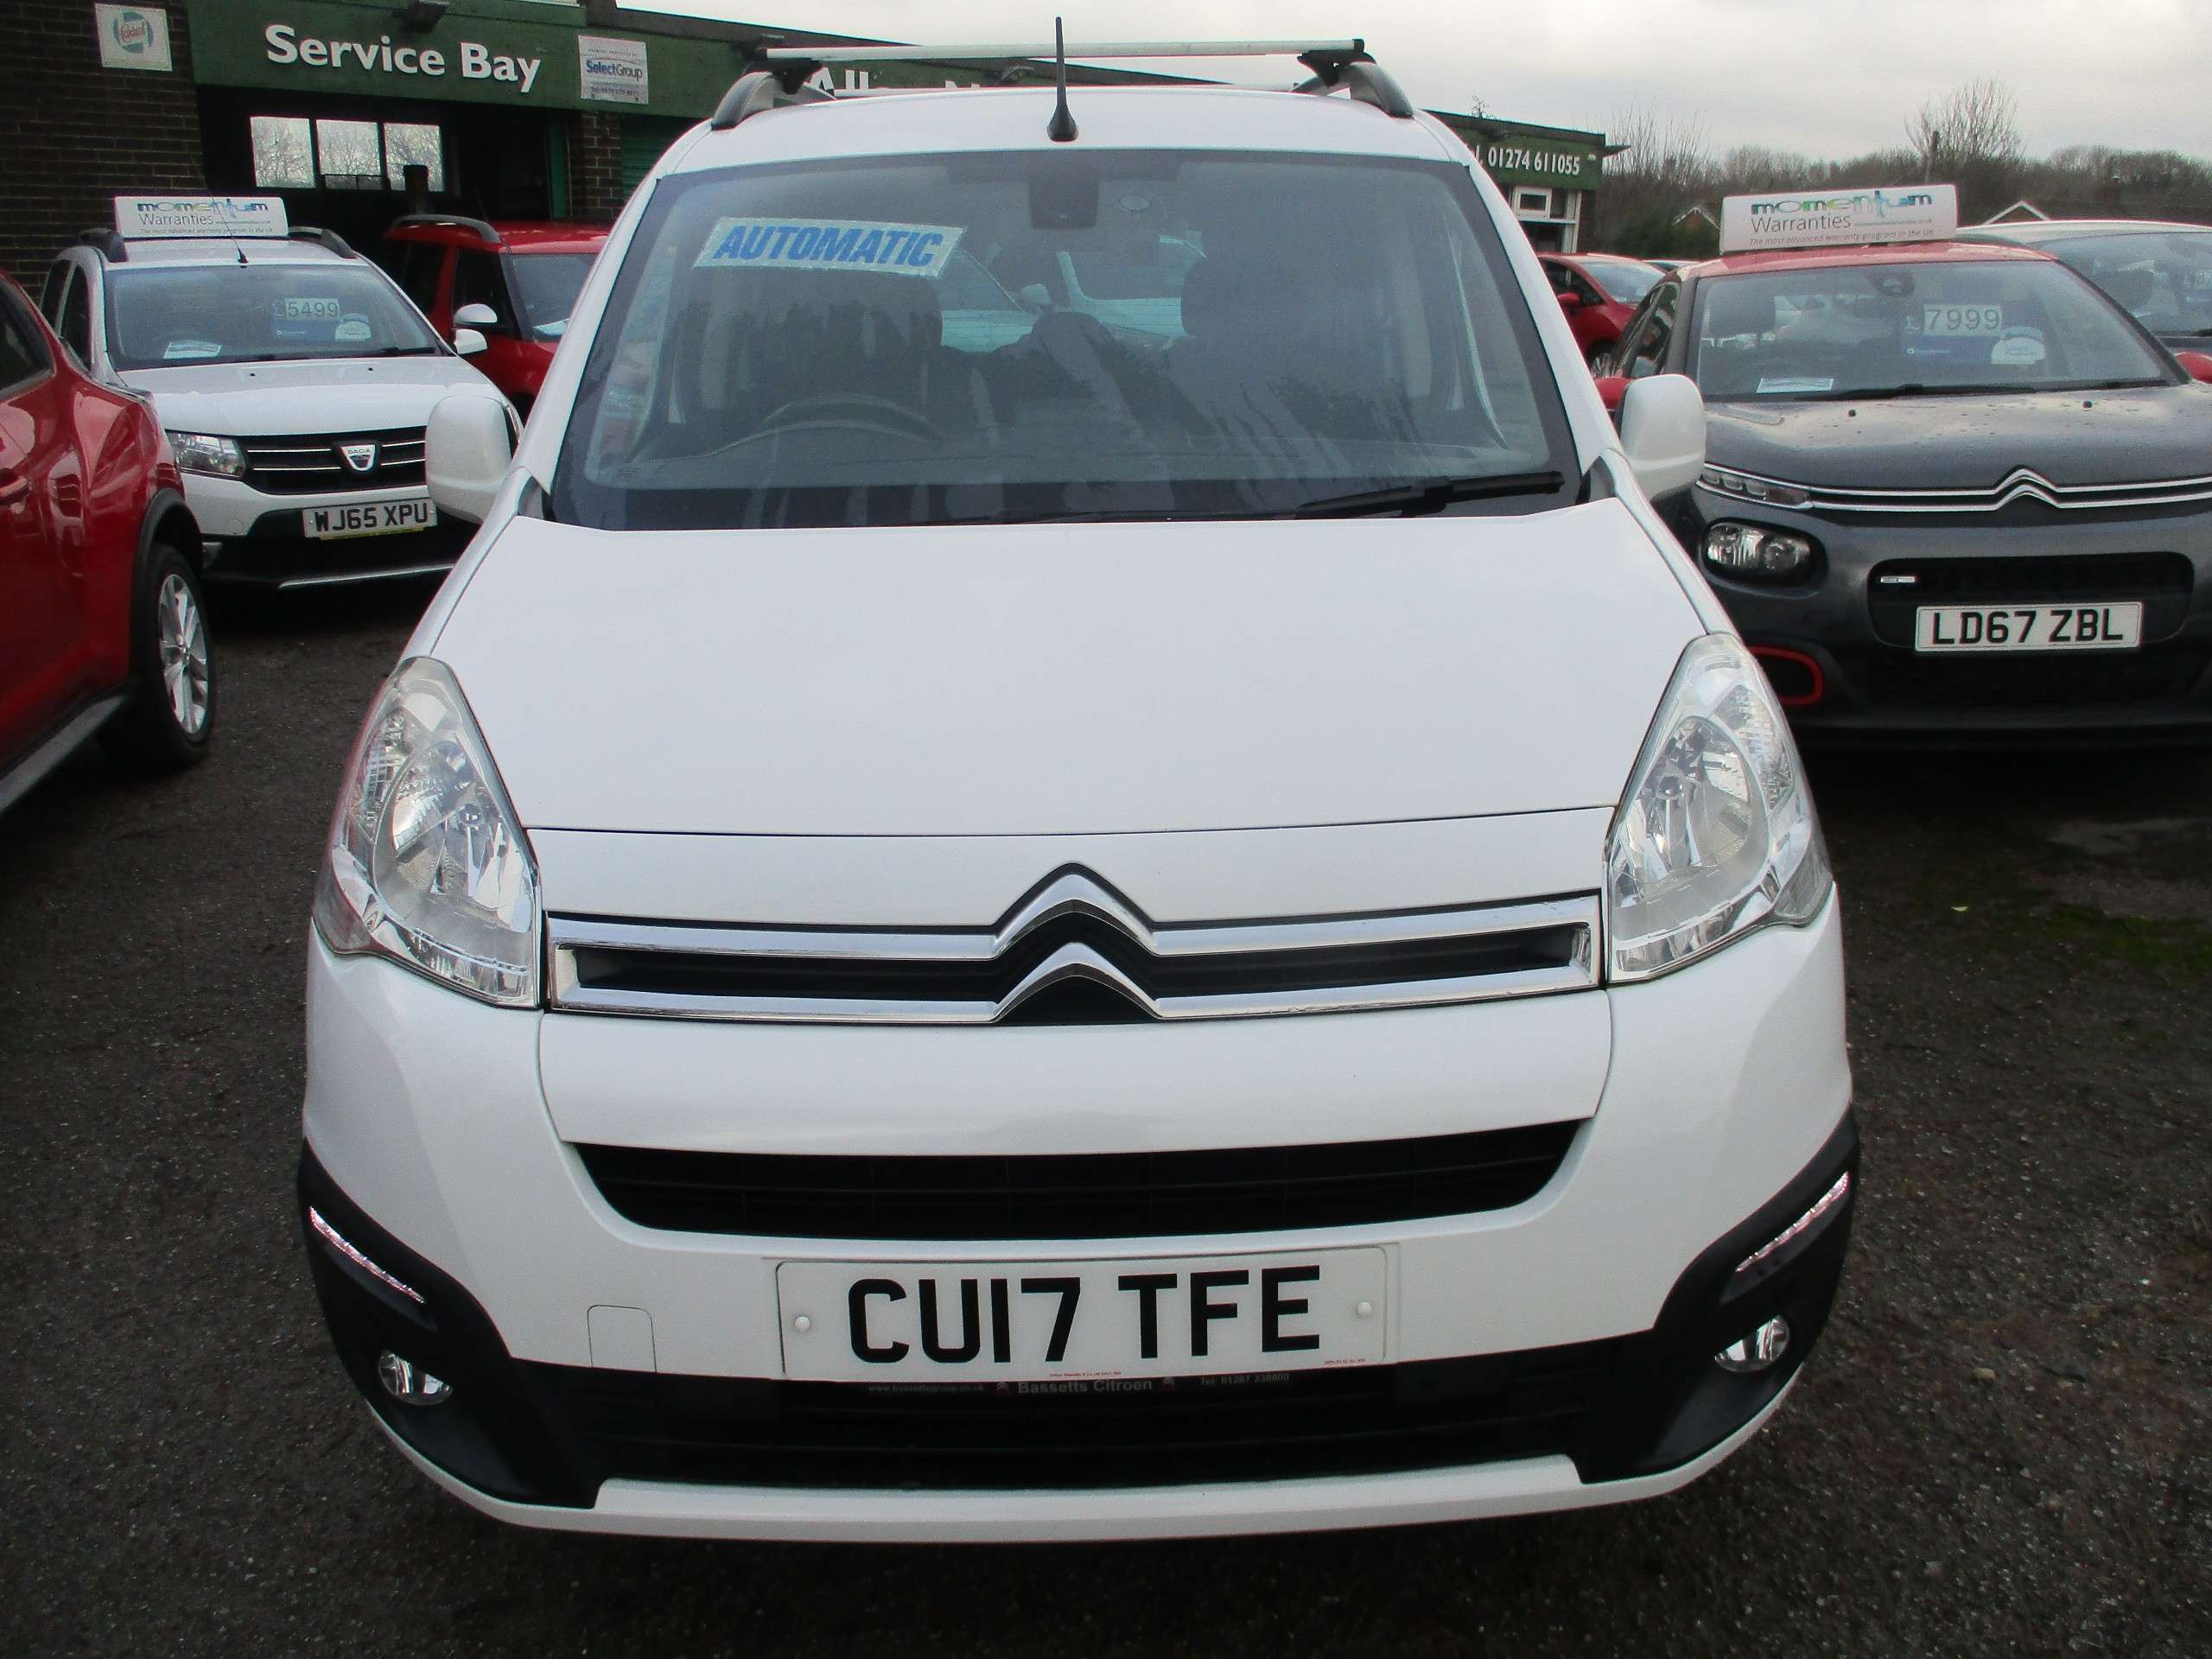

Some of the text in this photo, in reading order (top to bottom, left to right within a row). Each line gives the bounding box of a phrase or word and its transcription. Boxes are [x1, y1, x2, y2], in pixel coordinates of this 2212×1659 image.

[264, 23, 541, 93] Service Bay
[1487, 146, 1531, 170] 01274
[1534, 151, 1581, 175] 611055
[137, 198, 269, 218] momentum
[1751, 189, 1932, 217] momentum
[138, 213, 214, 226] Warranties
[1750, 213, 1852, 232] Warranties
[713, 224, 944, 268] AUTOMATIC
[1925, 308, 2001, 332] 7999
[314, 502, 429, 532] WJ65 XPU
[1932, 607, 2124, 645] LD67 ZBL
[847, 1264, 1321, 1364] CU17 TFE
[1017, 1381, 1088, 1395] Bassetts
